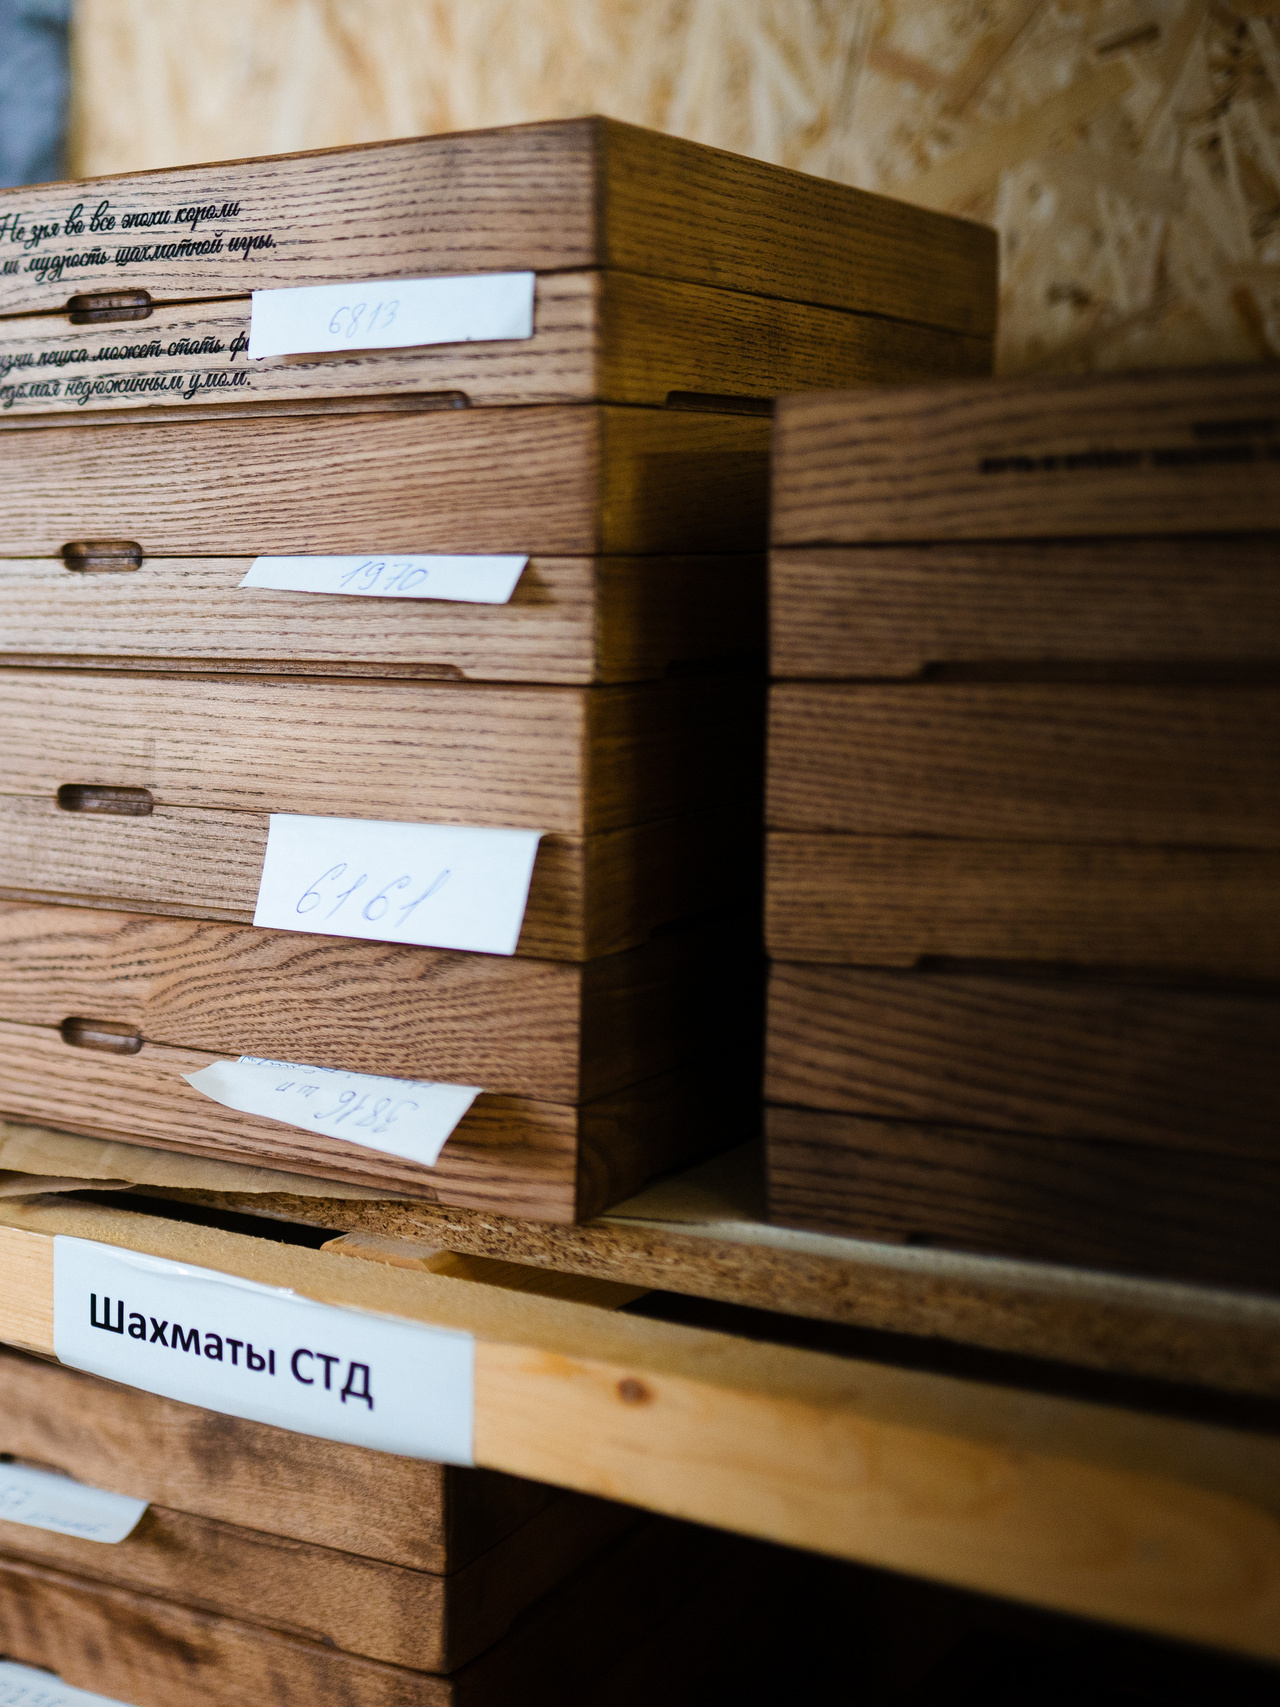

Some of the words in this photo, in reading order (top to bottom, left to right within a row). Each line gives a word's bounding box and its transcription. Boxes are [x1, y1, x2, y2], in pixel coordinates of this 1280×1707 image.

[24, 222, 60, 250] зря
[64, 203, 86, 235] во
[90, 200, 116, 232] все
[120, 209, 172, 231] эпохи
[173, 201, 241, 231] короли
[23, 246, 110, 281] мудрость
[115, 233, 223, 267] шахматной
[221, 234, 277, 260] игры.
[328, 299, 400, 339] 6813
[36, 348, 89, 367] пешка
[91, 339, 163, 363] может
[167, 336, 225, 358] стать
[63, 372, 184, 406] недюжинным
[183, 370, 252, 400] умом.
[338, 560, 430, 592] 1970
[89, 1293, 276, 1376] Шахматы
[290, 1347, 375, 1410] СТД
